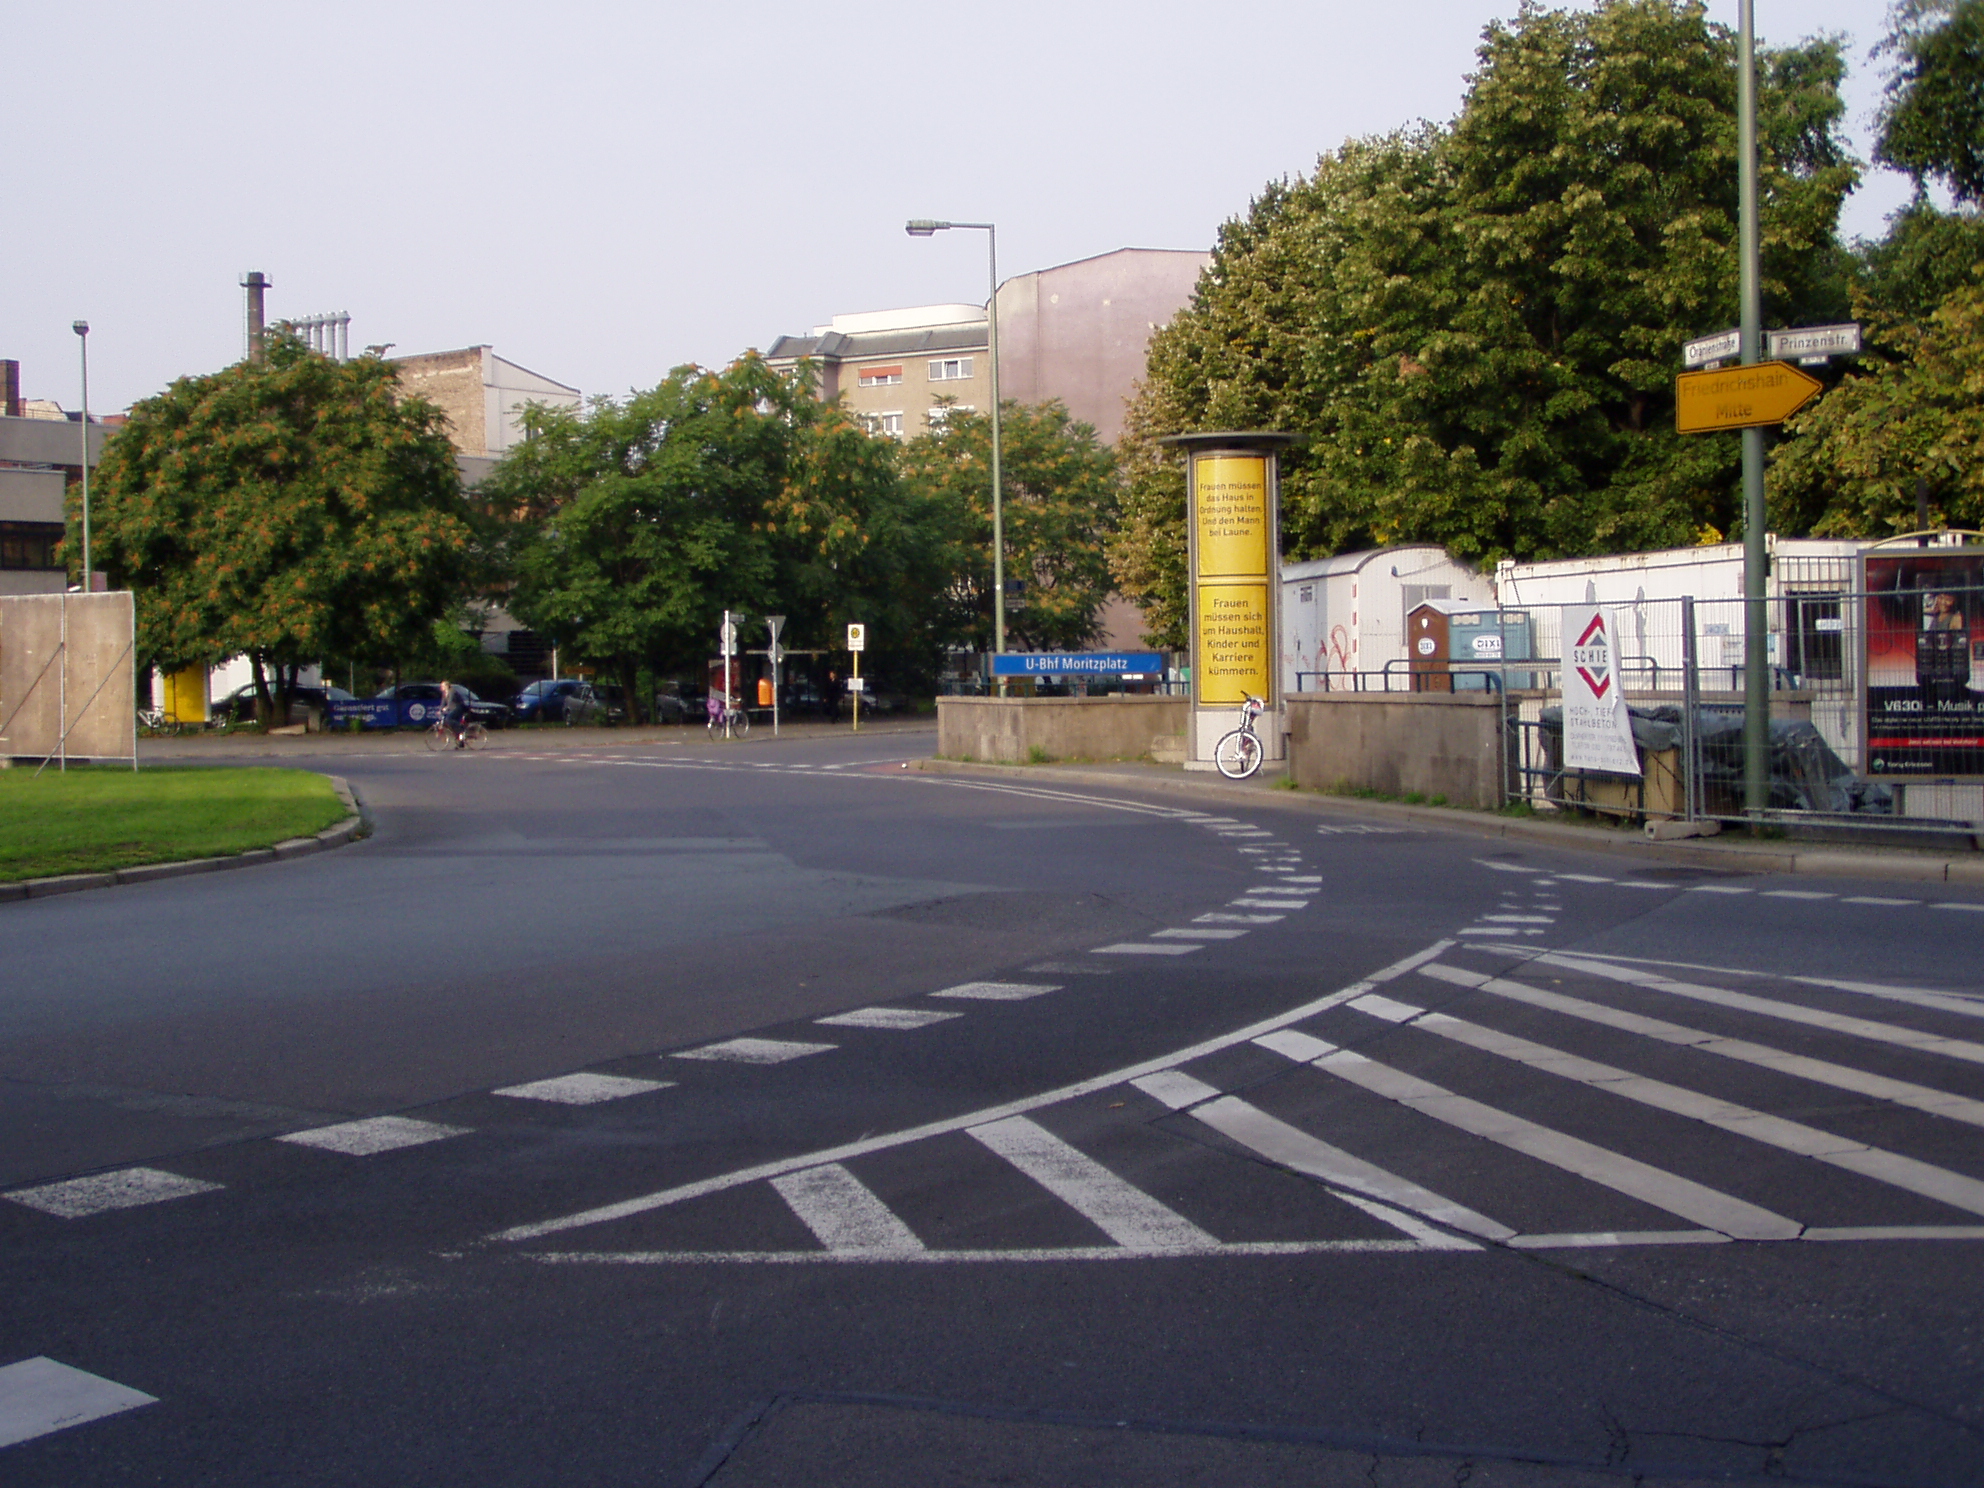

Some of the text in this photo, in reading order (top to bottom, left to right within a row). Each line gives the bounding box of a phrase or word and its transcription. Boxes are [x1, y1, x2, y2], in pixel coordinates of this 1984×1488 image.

[1780, 335, 1847, 350] Prinzenstr.
[1682, 370, 1788, 397] Friedrichshain
[1716, 403, 1752, 419] Mitte
[1200, 482, 1262, 491] Frauen müssen
[1206, 494, 1220, 502] das
[1247, 493, 1254, 501] in
[1200, 506, 1232, 514] Ordnung
[1202, 516, 1260, 525] Und den Mann
[1209, 529, 1221, 537] bei
[1213, 599, 1249, 608] Frauen
[1204, 612, 1262, 621] müssen sich
[1203, 627, 1216, 635] um
[1207, 639, 1260, 648] Kinder und
[1477, 640, 1500, 648] DIXI
[1212, 653, 1254, 662] Karriere
[1026, 657, 1128, 672] U-Bhf Moritzplatz
[1208, 667, 1259, 676] kümmern.
[1884, 700, 1923, 711] V630i
[1938, 699, 1974, 711] Musik
